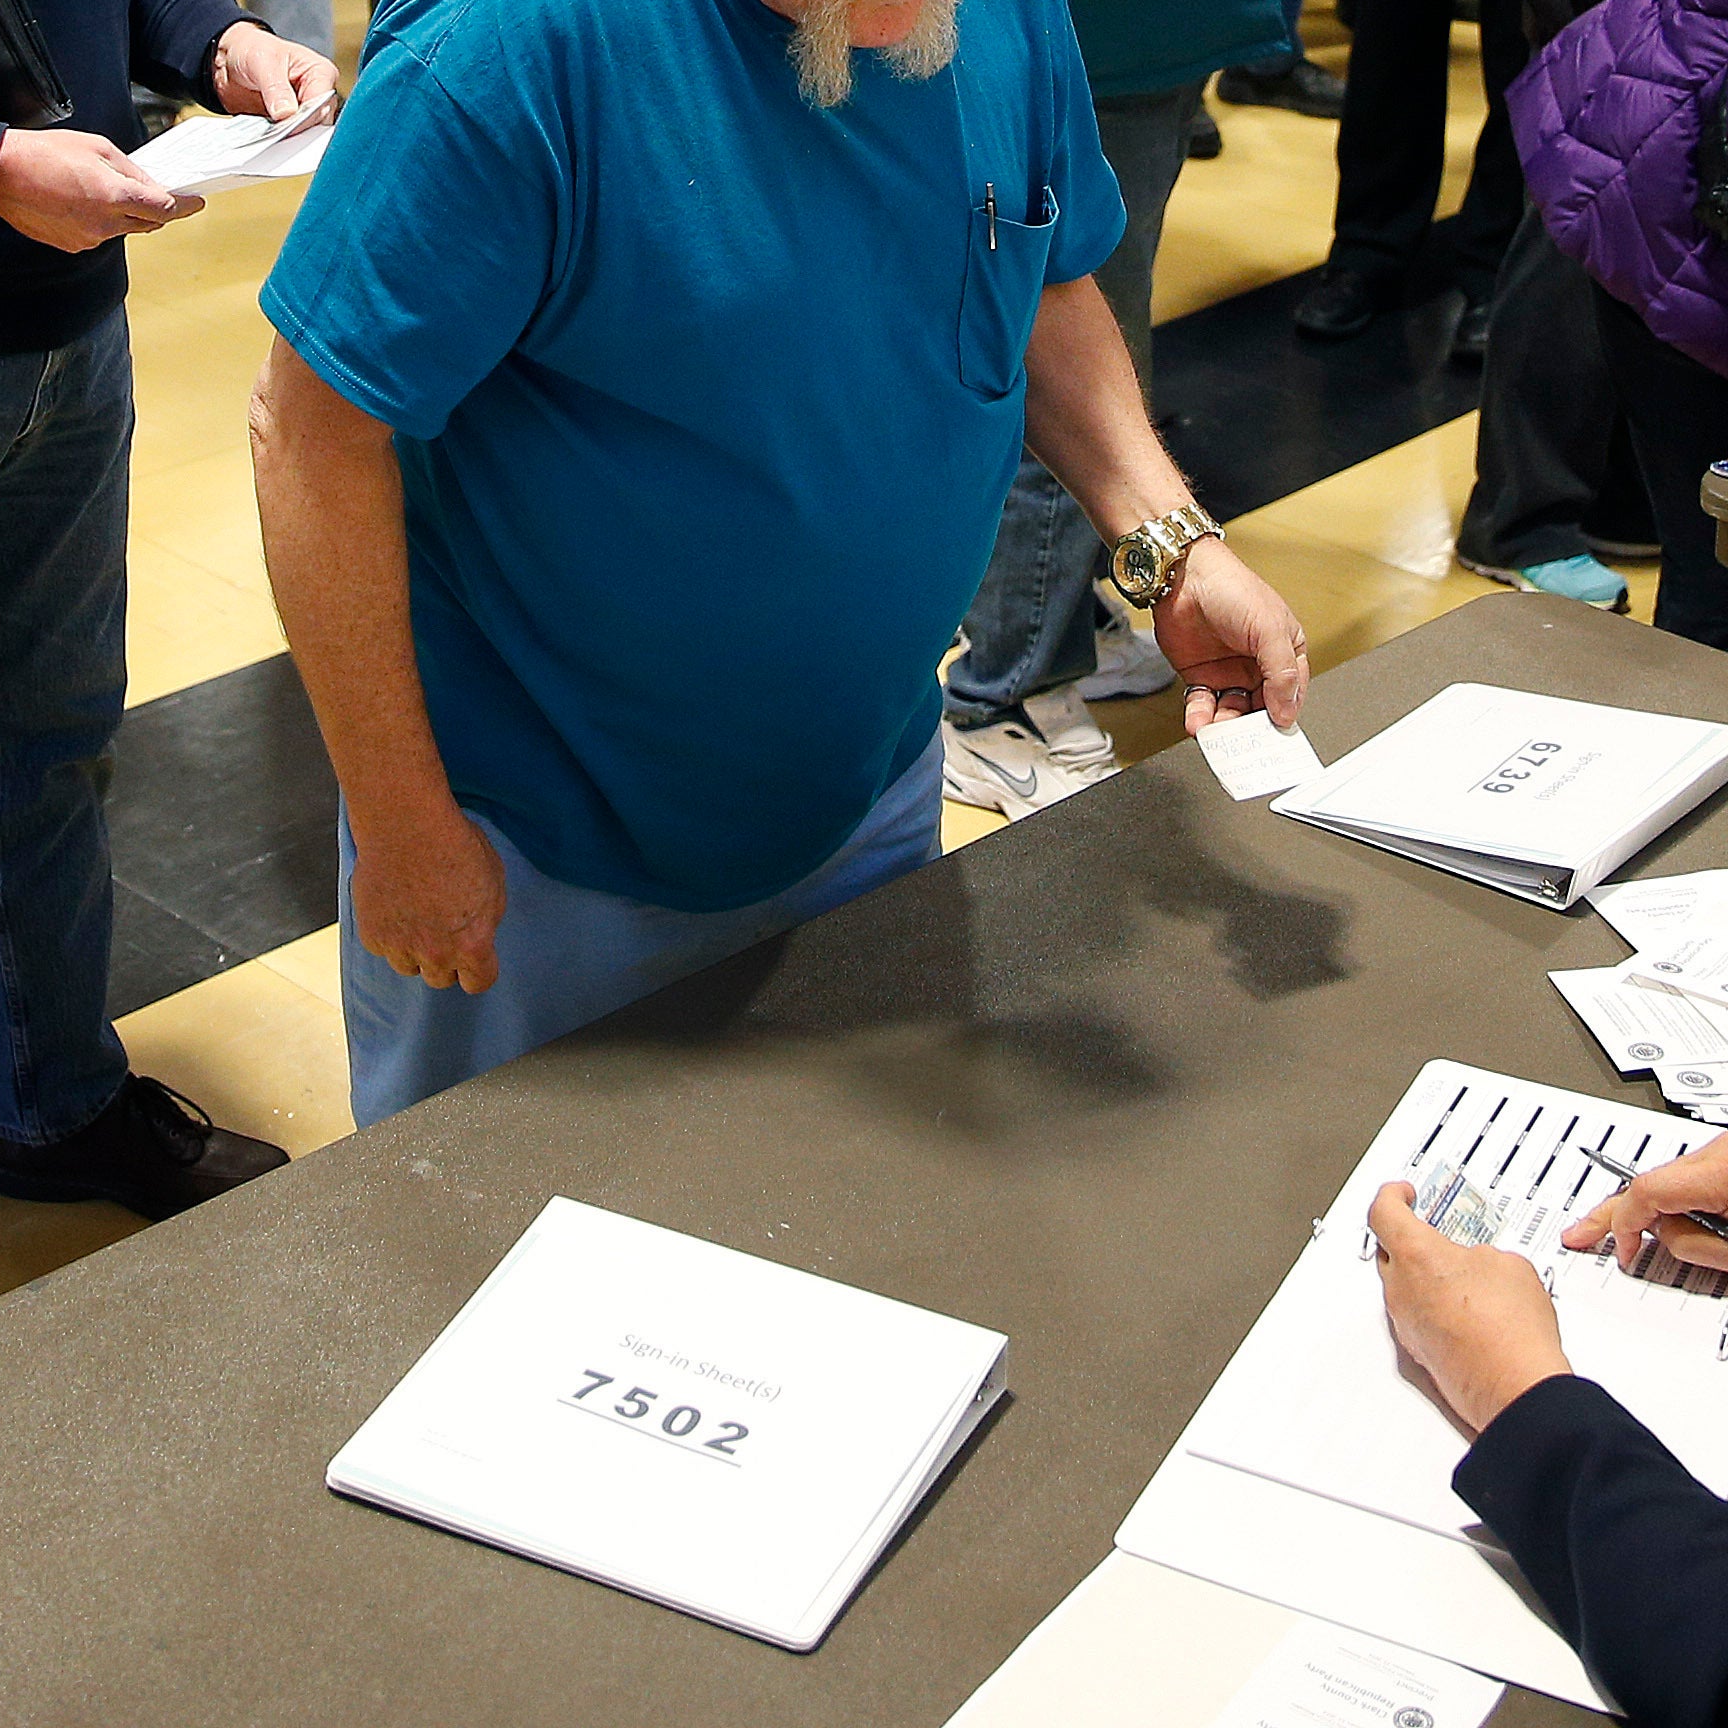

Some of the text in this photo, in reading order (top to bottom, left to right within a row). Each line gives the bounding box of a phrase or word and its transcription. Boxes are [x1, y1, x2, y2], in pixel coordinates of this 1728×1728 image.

[1482, 742, 1563, 794] 6739
[617, 1333, 784, 1404] Sign-in Sheet(s)
[571, 1368, 750, 1456] 7502
